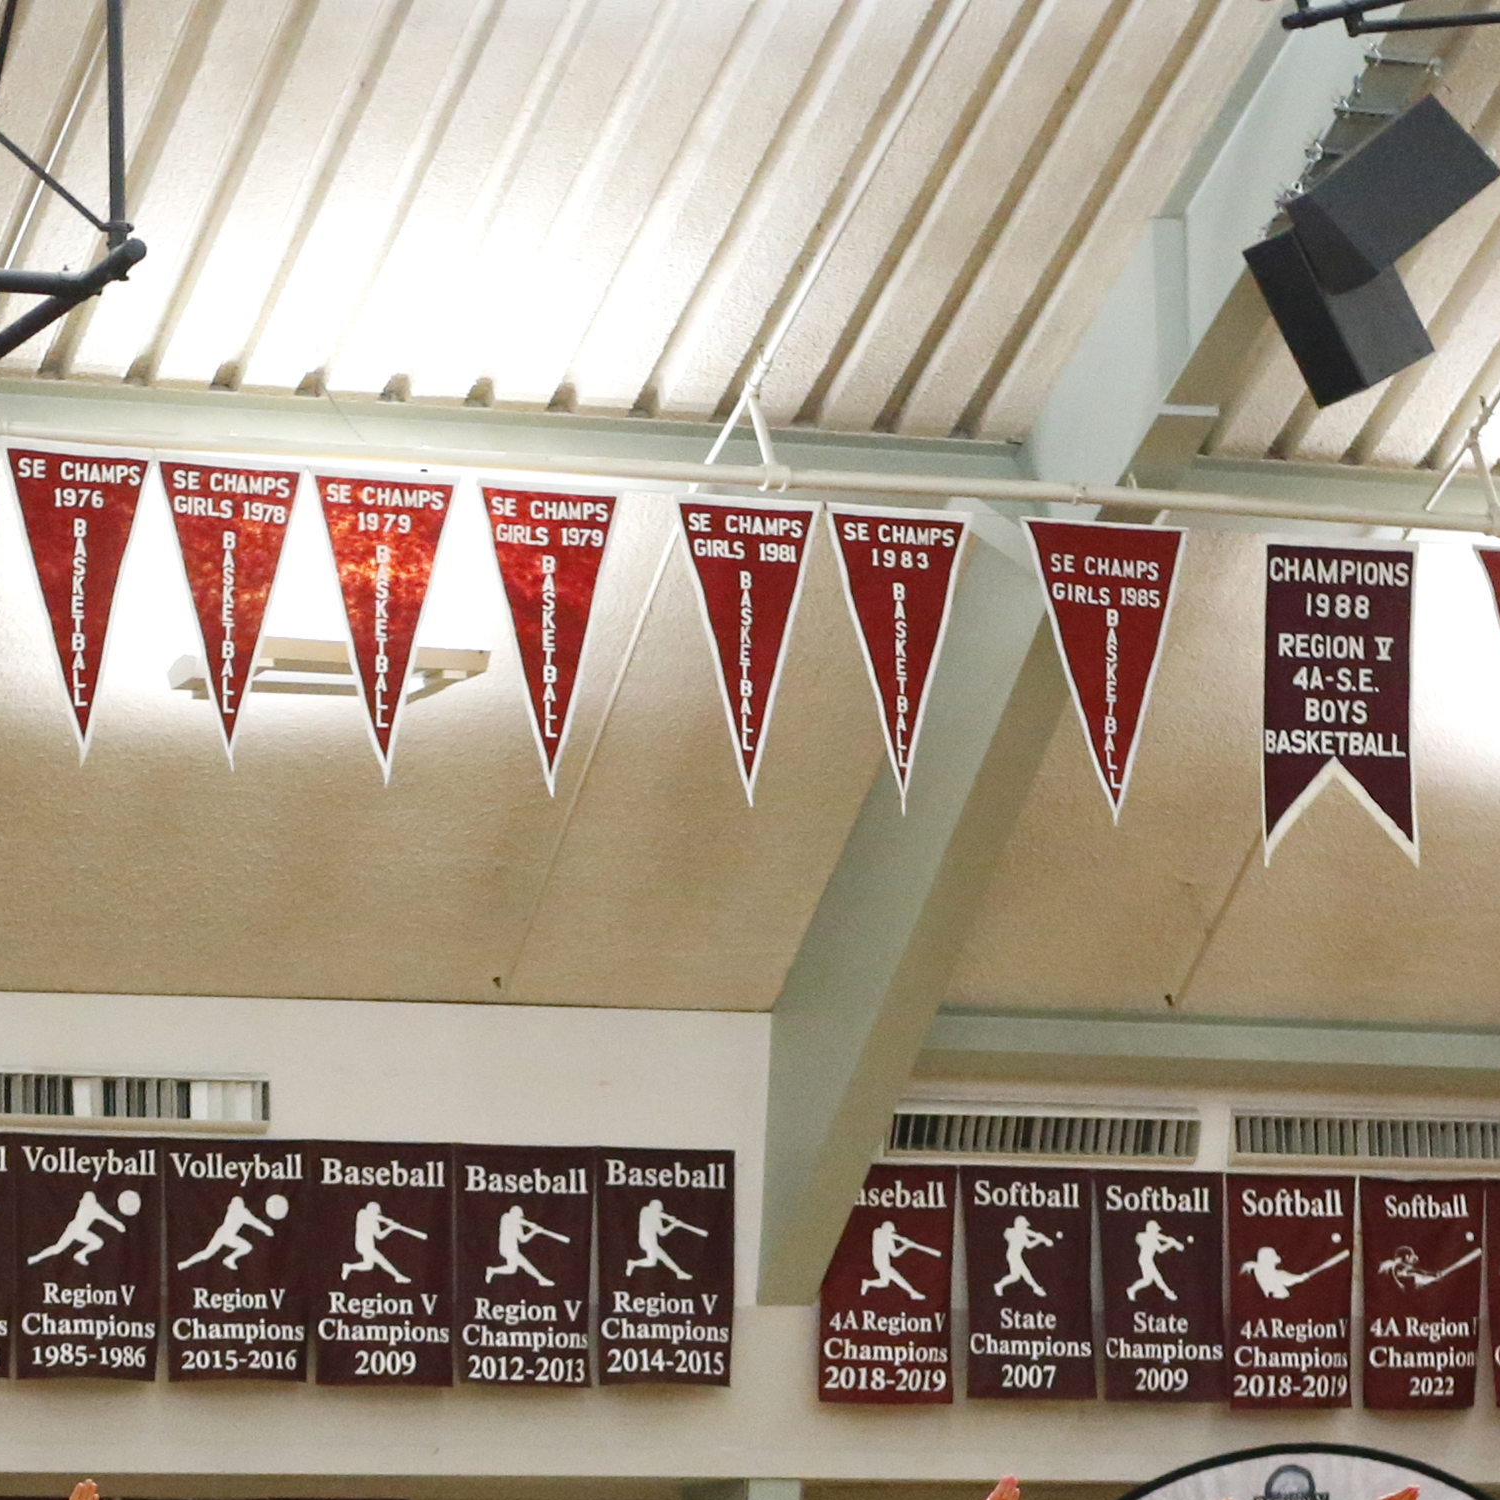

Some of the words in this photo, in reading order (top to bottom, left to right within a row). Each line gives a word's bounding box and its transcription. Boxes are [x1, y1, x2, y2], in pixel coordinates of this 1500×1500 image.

[17, 458, 46, 480] SE
[60, 461, 142, 487] CHAMPS
[173, 469, 203, 491] SE
[209, 472, 290, 498] CHAMPS
[53, 489, 104, 509] 1976
[326, 483, 356, 504] SE
[361, 484, 444, 511] CHAMPS
[491, 495, 516, 516] SE
[530, 500, 608, 523] CHAMPS
[174, 496, 233, 518] GIRLS
[242, 501, 286, 525] 1978
[357, 513, 412, 534] 1979
[496, 524, 549, 546] GIRLS
[561, 526, 603, 548] 1979
[725, 515, 803, 539] CHAMPS
[877, 525, 955, 548] CHAMPS
[694, 539, 745, 560] GIRLS
[759, 542, 797, 564] 1981
[871, 548, 930, 570] 1983
[1084, 556, 1159, 582] CHAMPS
[1269, 557, 1410, 586] CHAMPIONS
[1052, 583, 1111, 606] GIRLS
[1120, 586, 1161, 608] 1985
[1305, 595, 1370, 619] 1988
[1278, 634, 1365, 658] REGION
[1292, 667, 1380, 692] 4A-S.E.
[1305, 699, 1367, 724] BOYS
[1264, 730, 1407, 757] BASKETBALL
[22, 1145, 156, 1182] Volleyball
[170, 1152, 303, 1186] Volleyball
[321, 1158, 445, 1188] Baseball
[605, 1159, 726, 1189] Baseball
[465, 1165, 589, 1194] Baseball
[974, 1180, 1079, 1208] Softball
[1106, 1185, 1210, 1213] Softball
[1242, 1189, 1343, 1217] Softball
[1385, 1194, 1468, 1218] Softball
[43, 1282, 120, 1306] Region
[193, 1288, 266, 1312] Region
[329, 1292, 412, 1319] Region
[613, 1291, 695, 1318] Region
[475, 1298, 548, 1326] Region
[829, 1312, 862, 1332] 4A
[863, 1311, 931, 1335] Region
[1000, 1307, 1057, 1329] State
[1133, 1312, 1188, 1334] State
[22, 1313, 155, 1339] Champions
[172, 1318, 304, 1343] Champions
[317, 1319, 449, 1345] Champions
[462, 1324, 589, 1352] Champions
[601, 1318, 729, 1346] Champions
[1241, 1318, 1269, 1339] 4A
[1270, 1318, 1335, 1341] Region
[1370, 1318, 1399, 1337] 4A
[1406, 1318, 1467, 1341] Region
[32, 1345, 146, 1368] 1985-1986
[824, 1337, 948, 1365] Champions
[971, 1333, 1092, 1360] Champions
[1106, 1337, 1223, 1364] Champions
[181, 1350, 297, 1371] 2015-2016
[355, 1351, 416, 1376] 2009
[468, 1355, 585, 1383] 2012-2013
[607, 1349, 724, 1376] 2014-2015
[824, 1366, 947, 1391] 2018-2019
[1002, 1365, 1056, 1388] 2007
[1135, 1368, 1188, 1391] 2009
[1409, 1377, 1455, 1396] 2022
